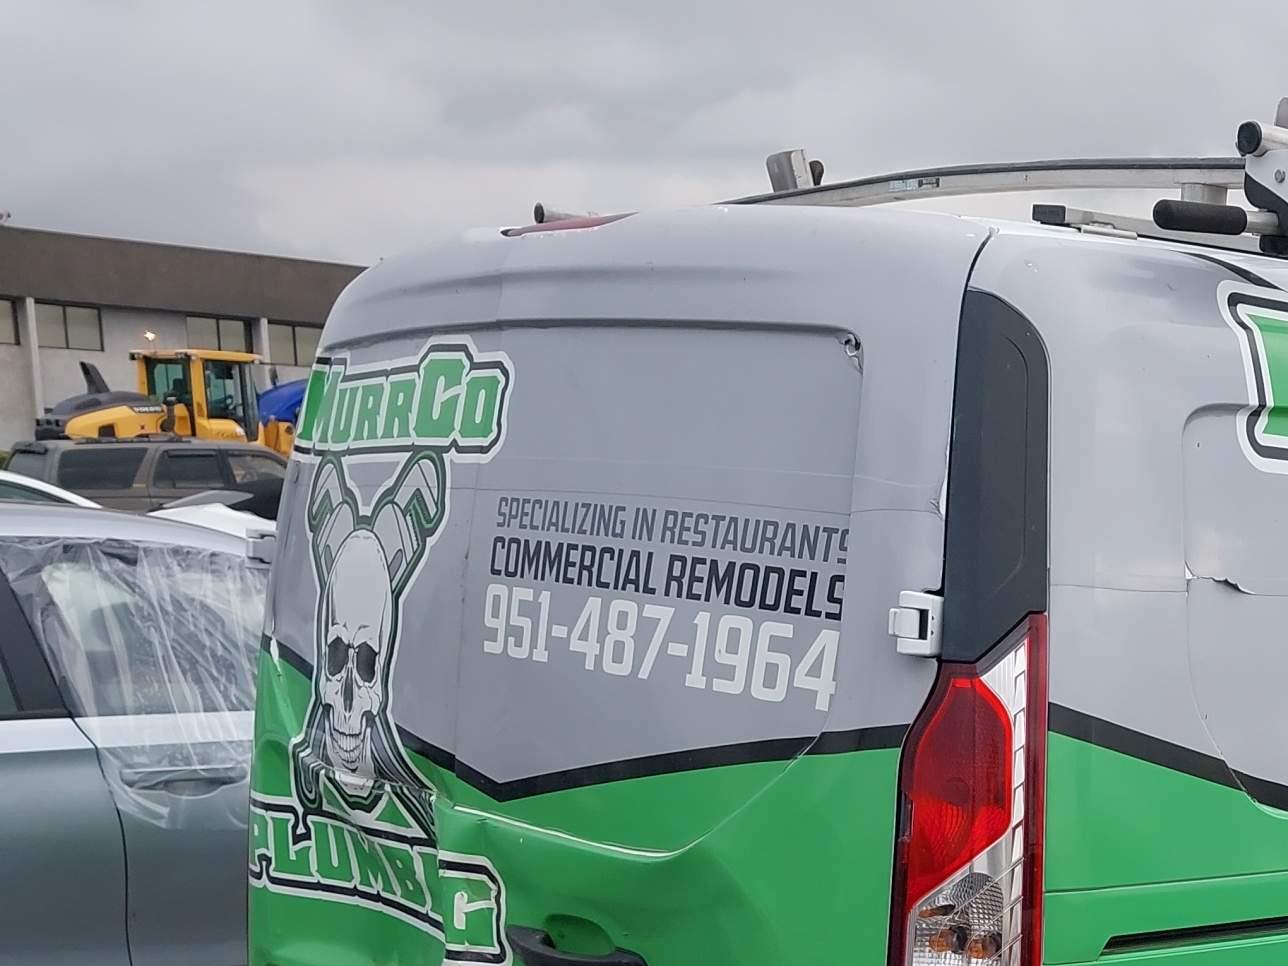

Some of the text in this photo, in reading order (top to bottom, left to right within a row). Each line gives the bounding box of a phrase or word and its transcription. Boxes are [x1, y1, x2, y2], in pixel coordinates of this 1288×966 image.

[496, 496, 850, 565] SPECIALIZING IN RESTAURANTS
[489, 535, 846, 621] COMMERCIAL REMODELS
[483, 583, 841, 712] 951-487-1964
